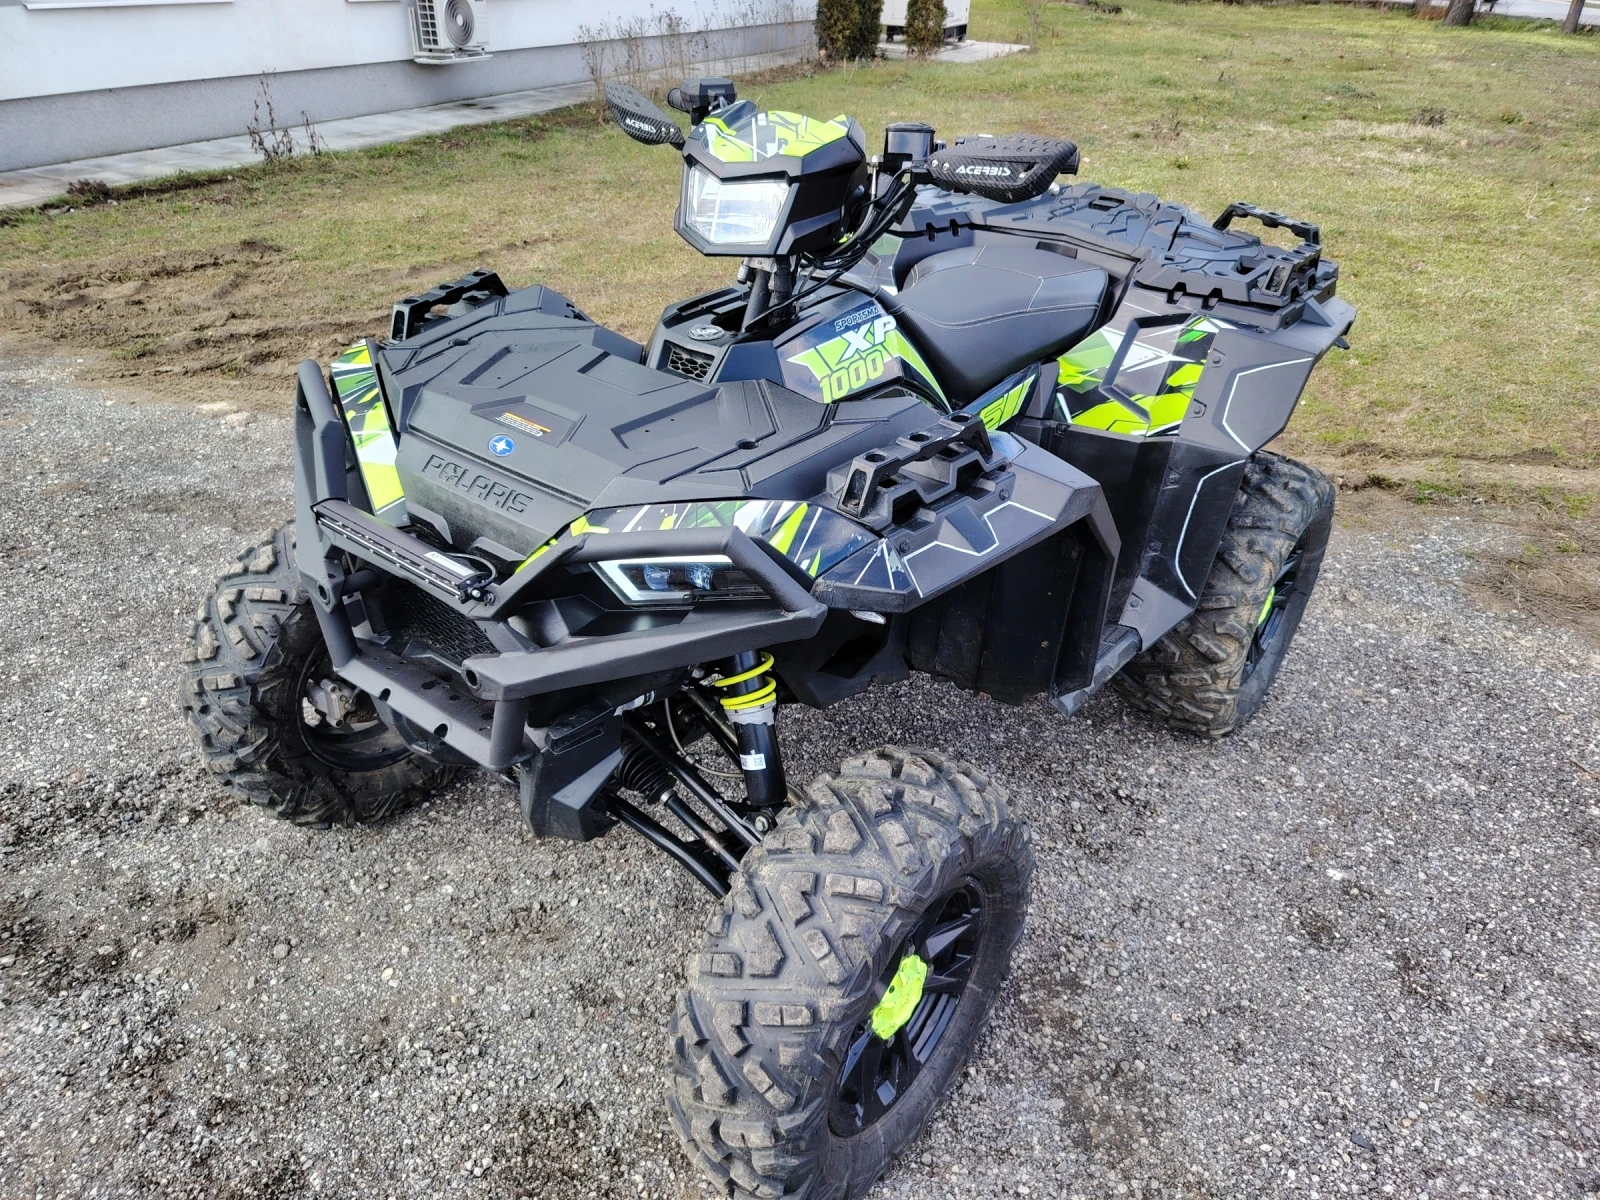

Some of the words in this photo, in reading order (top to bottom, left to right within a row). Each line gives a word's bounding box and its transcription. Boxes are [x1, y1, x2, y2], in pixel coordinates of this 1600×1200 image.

[625, 117, 657, 133] ACERBIS
[955, 163, 1011, 176] ACERBIS
[834, 305, 883, 332] SPORTSMA
[840, 315, 897, 362] XP
[819, 349, 885, 404] 1000
[422, 453, 534, 514] POLARIS
